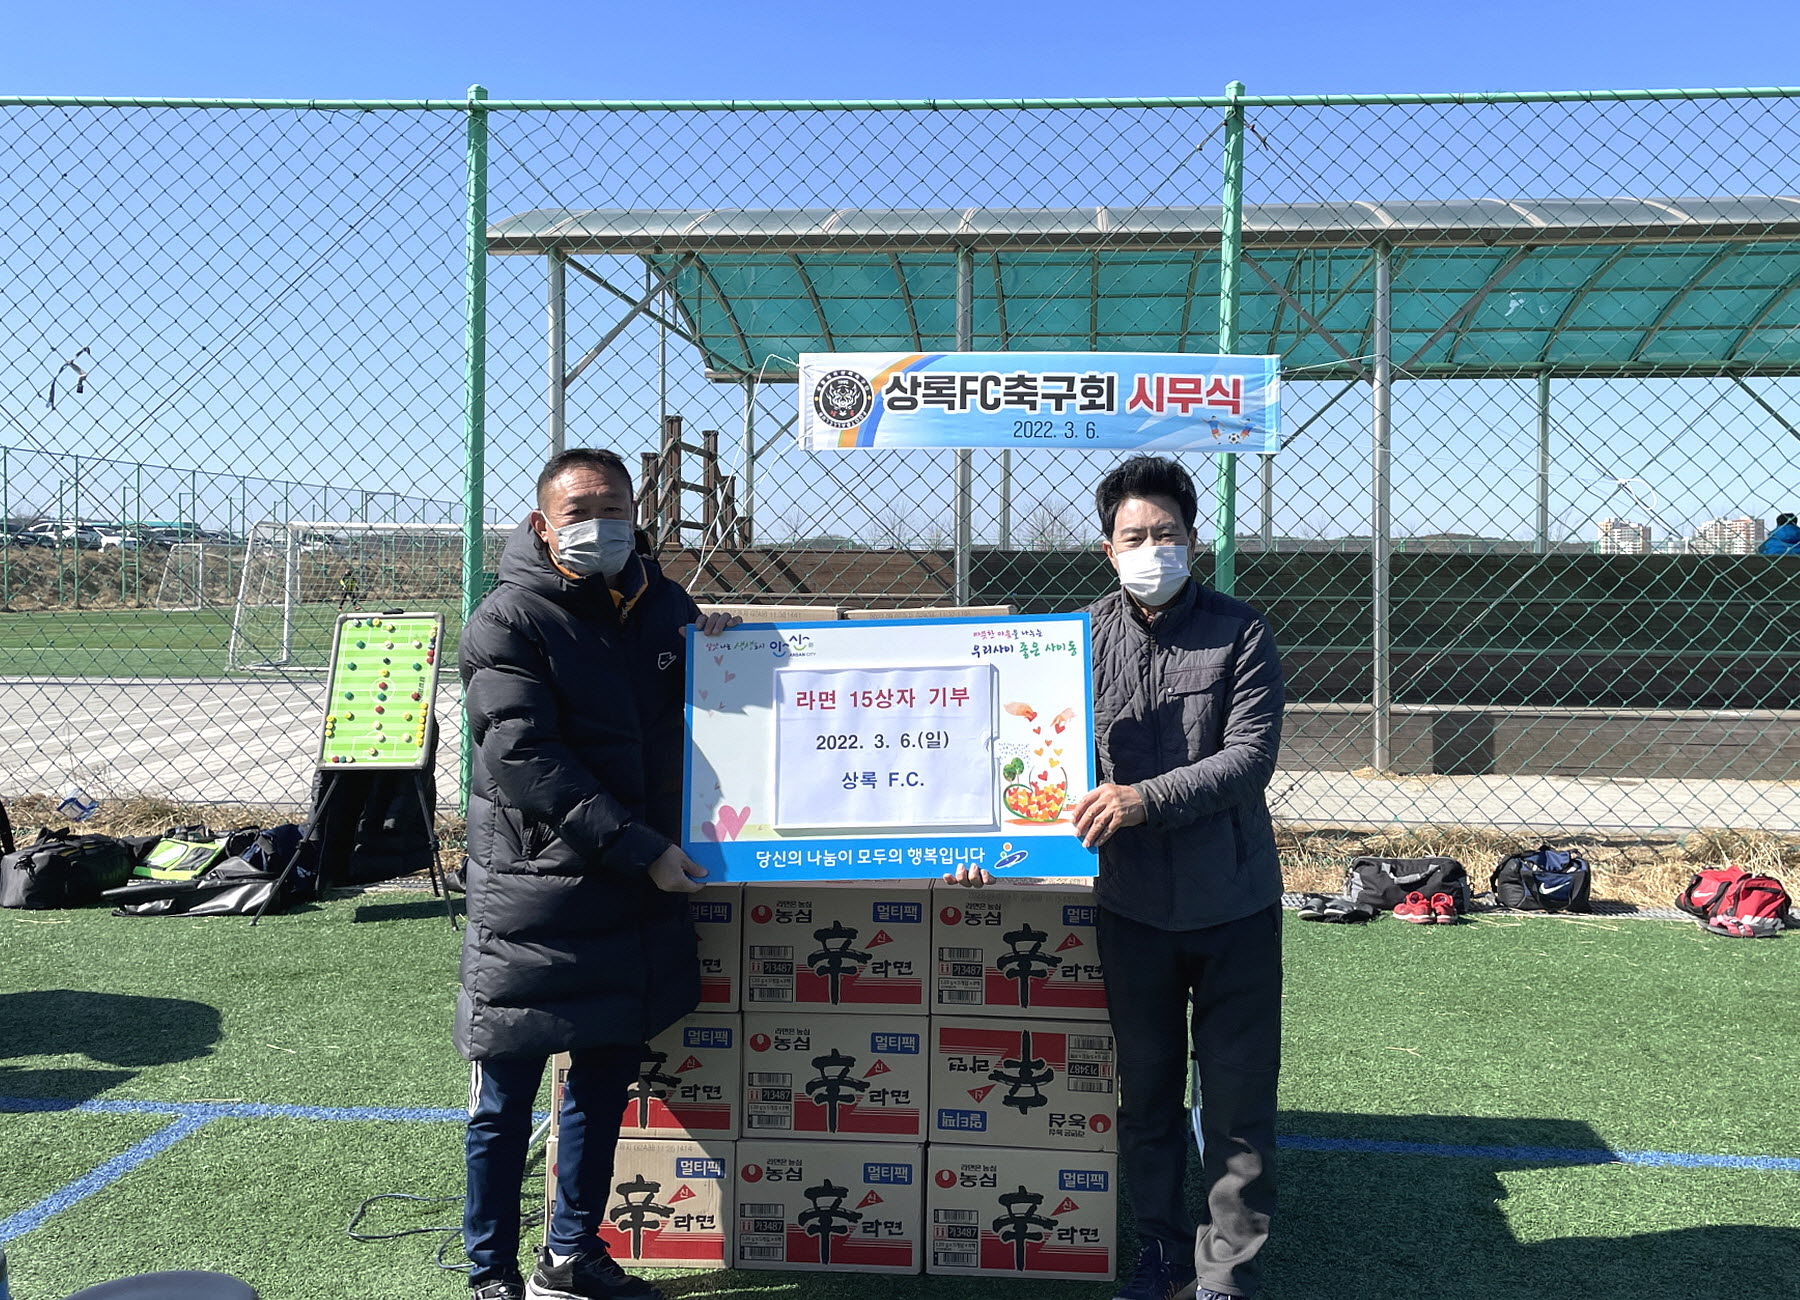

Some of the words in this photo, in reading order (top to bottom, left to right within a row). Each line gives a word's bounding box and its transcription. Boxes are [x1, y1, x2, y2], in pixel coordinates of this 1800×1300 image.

[885, 374, 1115, 412] 상록FC축구회
[1129, 376, 1241, 414] 시무식
[1013, 421, 1058, 440] 2022.
[1064, 421, 1079, 440] 3.
[1085, 421, 1101, 440] 6.
[997, 629, 1019, 640] 마음을
[1021, 628, 1044, 638] 나누는
[971, 644, 1014, 658] 우리사이
[1019, 641, 1041, 659] 좋은
[1045, 640, 1078, 656] 사이동
[796, 688, 837, 710] 라면
[849, 688, 915, 709] 15상자
[929, 685, 970, 706] 기부
[816, 733, 864, 750] 2022.
[874, 734, 890, 749] 3.
[900, 731, 949, 750] 6.(일)
[841, 771, 878, 790] 상록
[889, 772, 925, 788] F.C.
[756, 850, 802, 868] 당신의
[807, 849, 853, 867] 나눔이
[857, 848, 903, 866] 모두의
[907, 846, 985, 866] 행복입니다
[775, 910, 812, 924] 농심
[877, 904, 918, 920] 멀티팩
[964, 910, 1002, 926] 농심
[1067, 908, 1097, 923] 멀티
[807, 920, 873, 1005] 辛
[872, 960, 913, 978] 라면
[997, 923, 1063, 1009] 辛
[1061, 963, 1104, 982] 라면
[687, 1030, 730, 1046] 멀티팩
[773, 1036, 810, 1051] 농심
[875, 1035, 916, 1052] 멀티팩
[948, 1056, 990, 1074] 라면
[680, 1083, 722, 1102] 라면
[805, 1048, 870, 1133] 辛
[869, 1088, 911, 1106] 라면
[942, 1112, 983, 1129] 멀티팩
[1049, 1113, 1087, 1129] 농심
[680, 1160, 722, 1176] 멀티팩
[765, 1167, 802, 1182] 농심
[868, 1166, 908, 1182] 멀티팩
[960, 1171, 997, 1188] 농심
[1063, 1172, 1104, 1189] 멀티팩
[609, 1174, 675, 1260] 辛
[673, 1214, 716, 1231] 라면
[798, 1178, 863, 1265] 辛
[862, 1218, 904, 1237] 라면
[992, 1185, 1058, 1271] 辛
[1057, 1226, 1100, 1244] 라면
